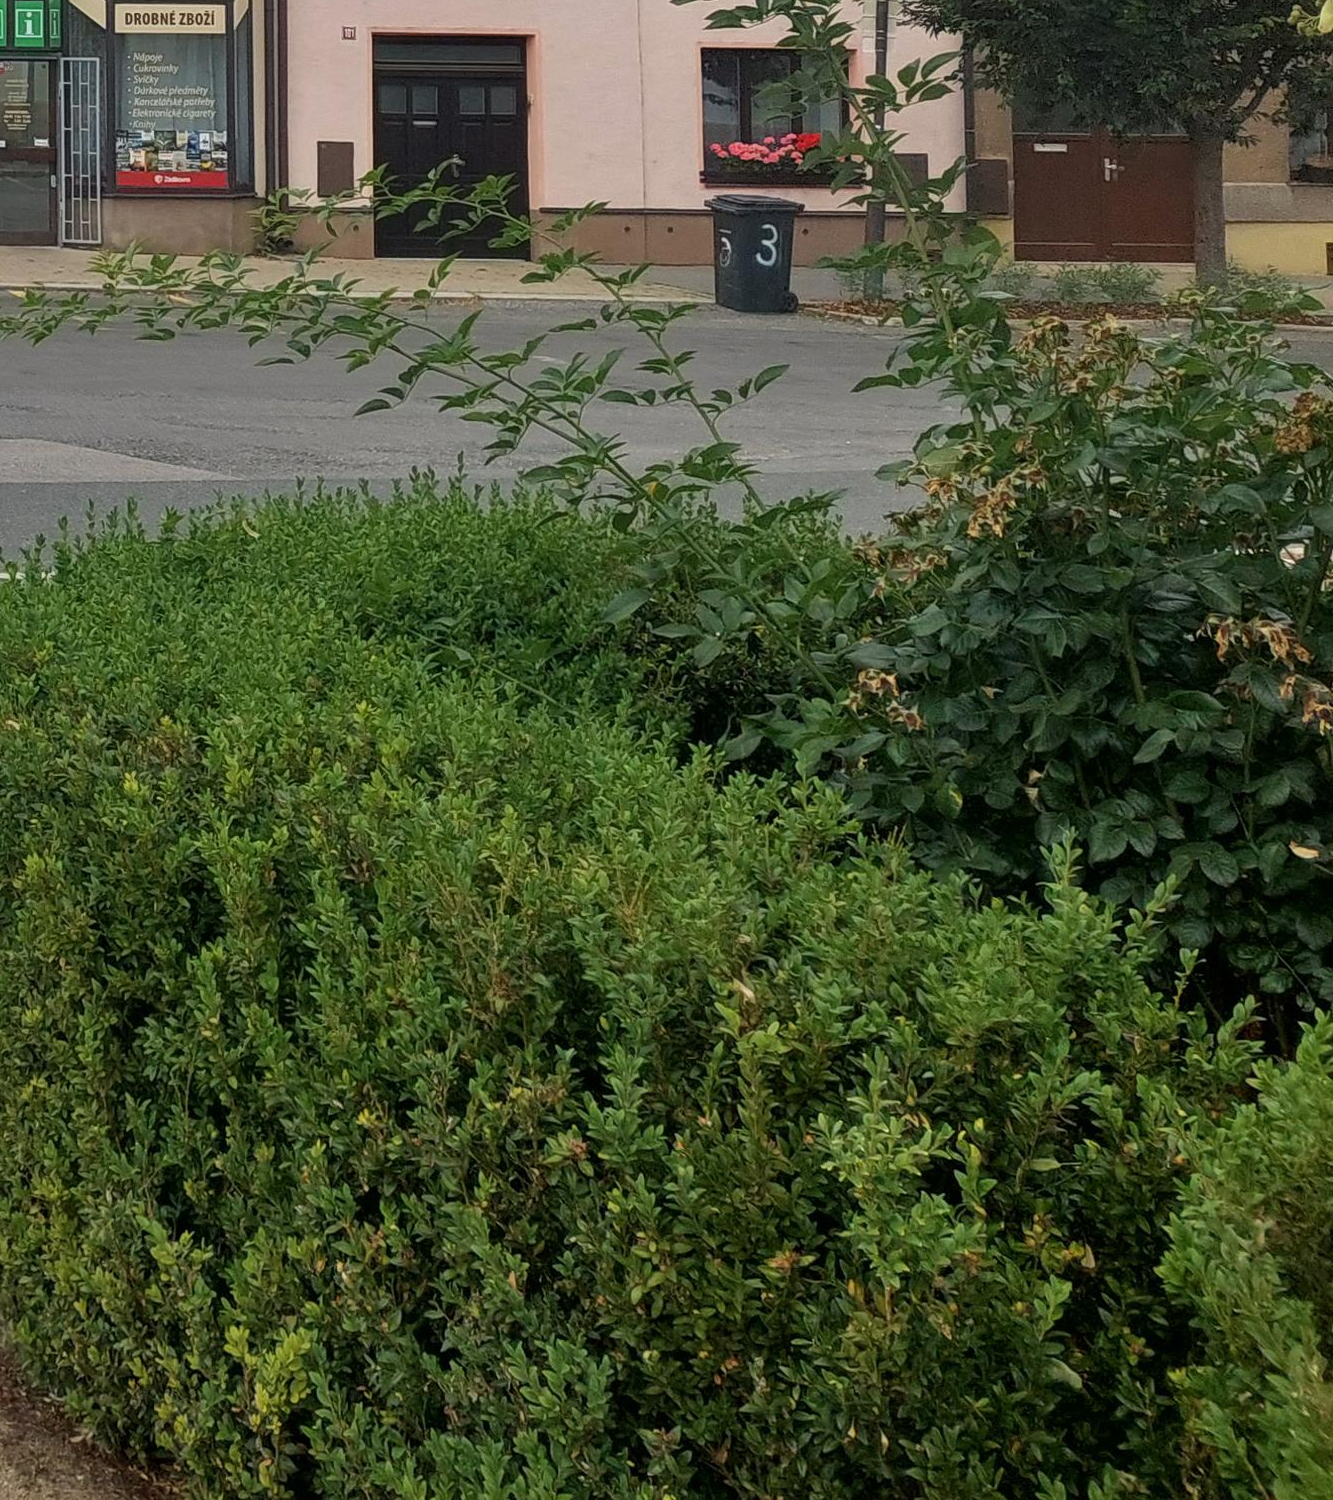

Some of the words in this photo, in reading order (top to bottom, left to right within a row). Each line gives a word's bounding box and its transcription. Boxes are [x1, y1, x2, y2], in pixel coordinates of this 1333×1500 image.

[125, 10, 176, 26] DROBNÉ
[178, 10, 215, 26] ZBOŽÍ
[133, 52, 163, 64] Nápoje
[133, 63, 179, 74] Cukrovinky
[756, 224, 779, 267] 3
